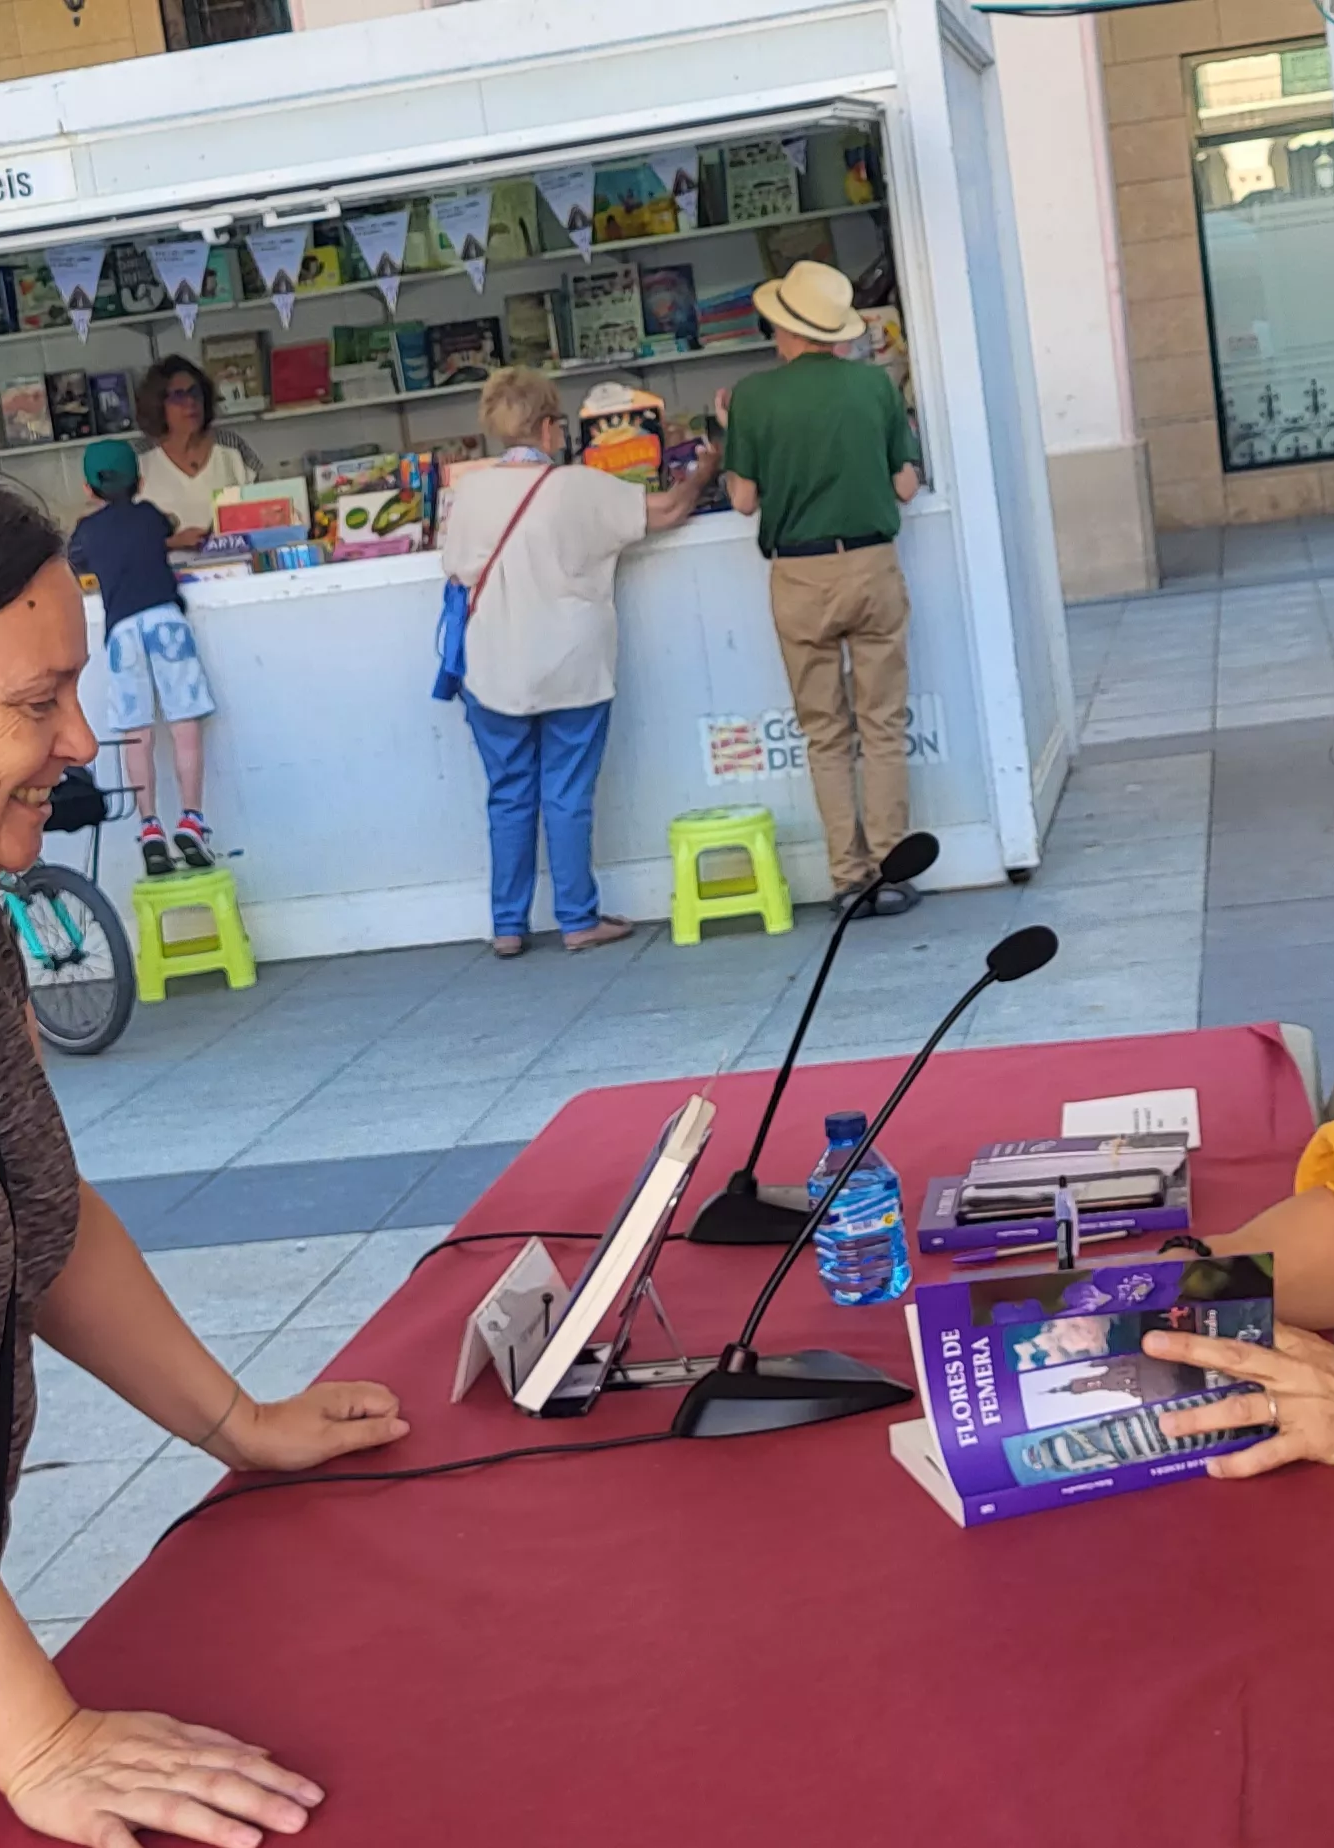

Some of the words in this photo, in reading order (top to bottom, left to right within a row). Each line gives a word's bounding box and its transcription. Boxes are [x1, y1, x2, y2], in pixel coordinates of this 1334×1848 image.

[768, 746, 804, 771] DE
[940, 1328, 965, 1357] DE
[945, 1361, 979, 1449] FLORES
[970, 1335, 1003, 1426] FEMERA
